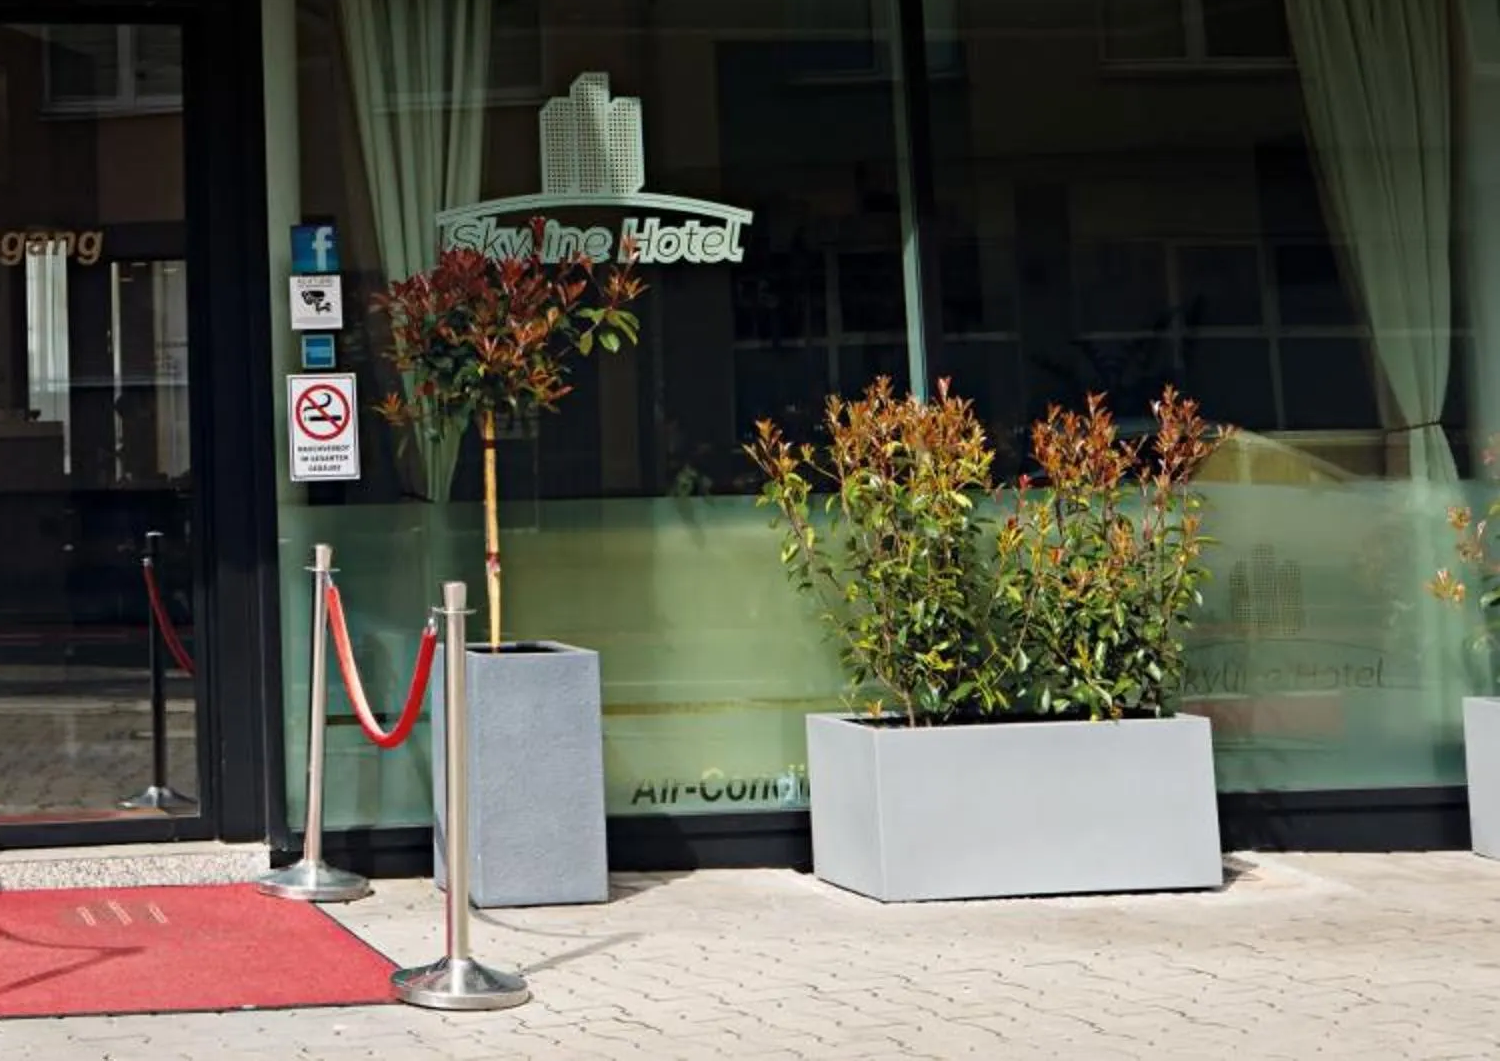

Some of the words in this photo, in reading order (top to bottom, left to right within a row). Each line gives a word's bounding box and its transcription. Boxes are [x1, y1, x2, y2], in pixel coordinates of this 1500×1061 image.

[312, 226, 333, 272] f
[446, 216, 613, 265] Skyine
[616, 215, 745, 264] Hotel
[631, 764, 812, 805] Air-Condi
